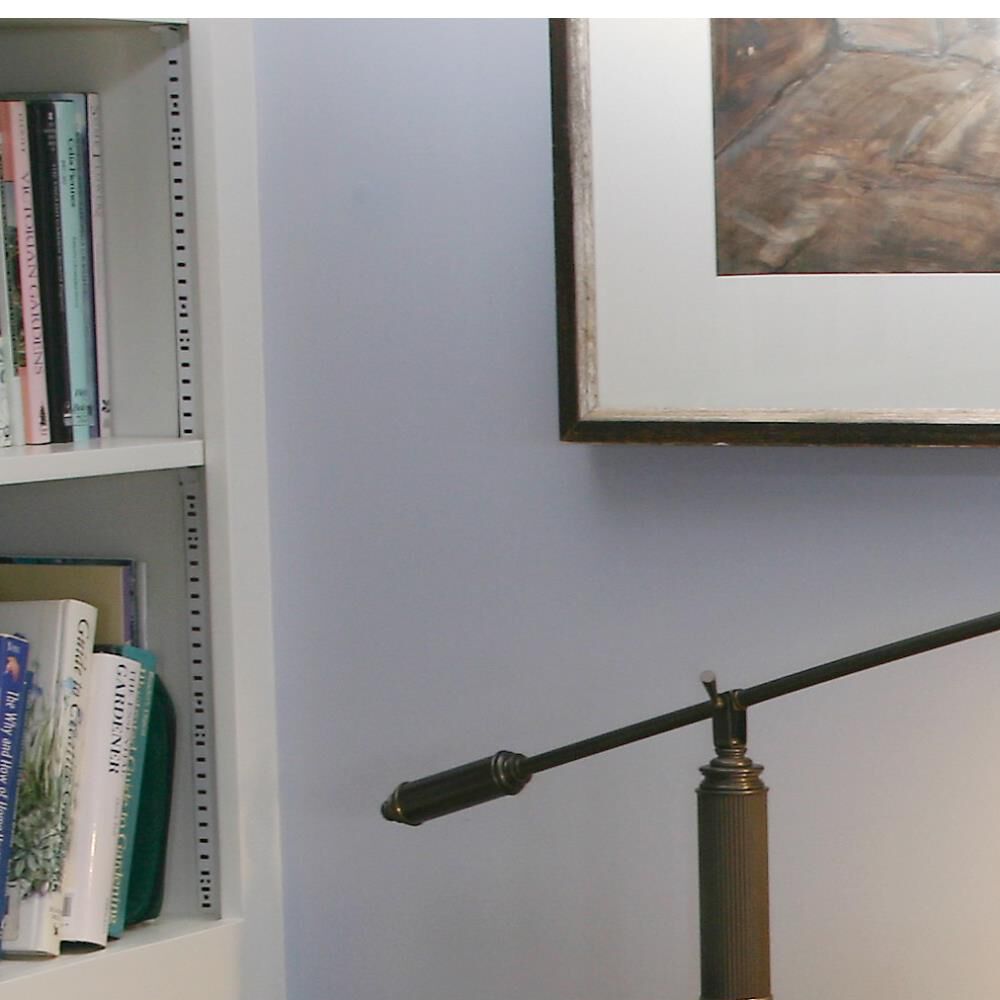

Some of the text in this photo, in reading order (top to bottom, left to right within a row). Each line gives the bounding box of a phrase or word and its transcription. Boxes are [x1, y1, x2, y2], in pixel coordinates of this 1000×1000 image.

[21, 172, 38, 278] VICTORIAN
[30, 284, 43, 375] GARDENS
[74, 619, 89, 676] Guide
[5, 691, 19, 709] The
[72, 680, 82, 697] to
[0, 713, 17, 736] Why
[108, 663, 127, 775] GARDENER
[0, 738, 12, 758] and
[0, 758, 13, 784] How
